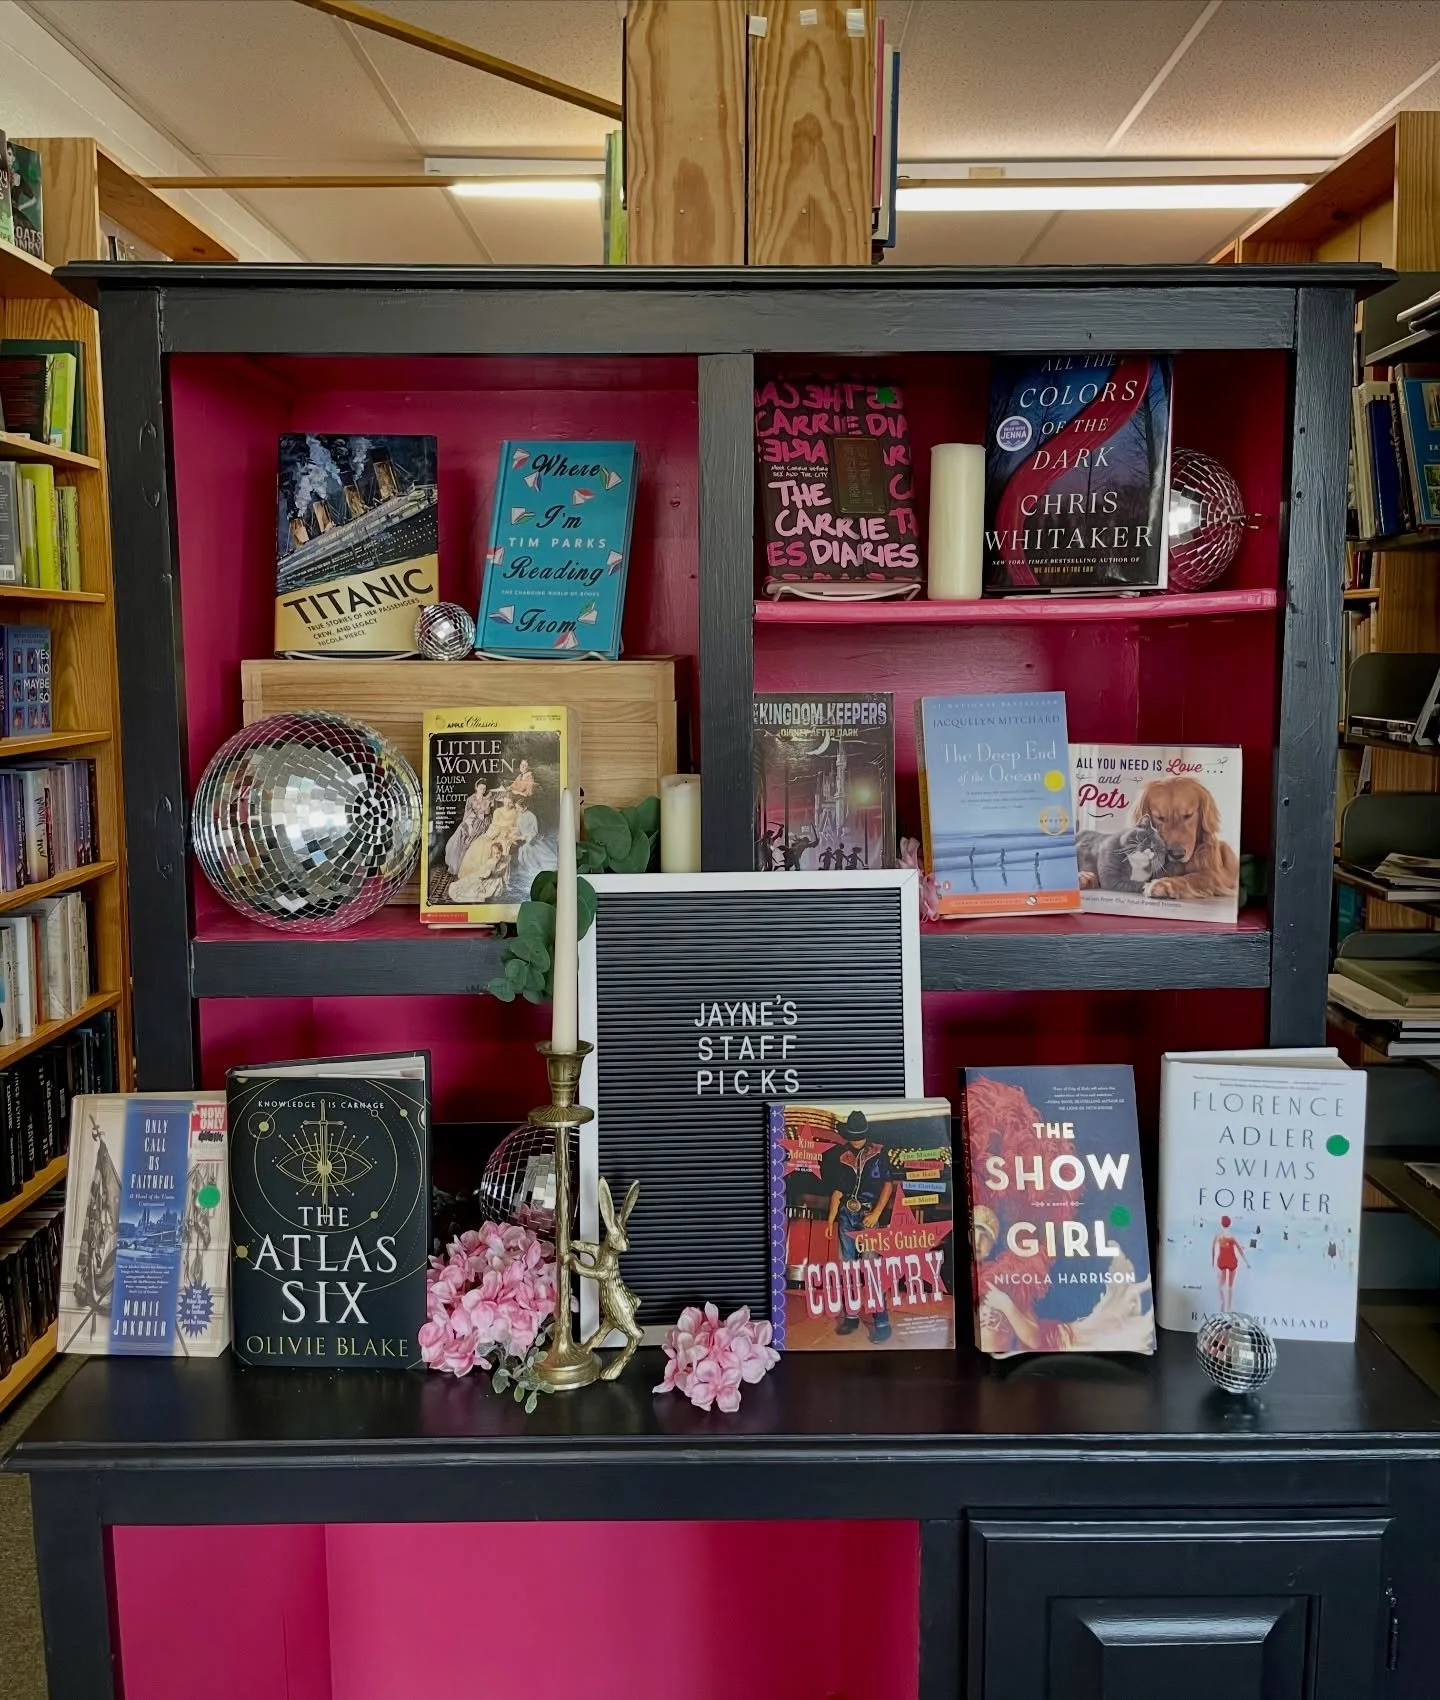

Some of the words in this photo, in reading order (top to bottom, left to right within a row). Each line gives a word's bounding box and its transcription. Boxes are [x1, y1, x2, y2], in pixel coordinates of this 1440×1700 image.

[1042, 358, 1073, 373] ALL
[1020, 380, 1138, 408] COLORS
[755, 408, 864, 437] CARRIE
[1041, 421, 1067, 435] OF
[1074, 417, 1109, 433] THE
[1001, 430, 1026, 439] JENNA
[532, 454, 601, 477] Where
[1032, 447, 1115, 471] DARK
[768, 480, 832, 508] THE
[1021, 491, 1118, 516] CHRIS
[536, 505, 582, 528] I'm
[775, 508, 889, 541] CARRIE
[508, 538, 539, 548] TIM
[552, 538, 606, 548] PARKS
[984, 526, 1153, 551] WHITAKER
[810, 538, 919, 569] DIARIES
[503, 556, 604, 587] Reading
[283, 568, 433, 624] TITANIC
[308, 622, 325, 632] TRUE
[326, 615, 352, 628] STORIES
[364, 609, 377, 617] HER
[379, 597, 423, 614] PASSENGERS,
[515, 609, 578, 633] From
[313, 630, 335, 640] CREW,
[336, 626, 351, 634] AND
[353, 618, 378, 630] LEGACY
[318, 635, 344, 647] NICOLA
[345, 630, 366, 640] PIERCE
[35, 648, 50, 660] YES
[38, 663, 50, 674] NO
[23, 679, 50, 690] MAYBE
[39, 692, 50, 703] SO
[464, 715, 499, 728] Classics
[759, 703, 823, 725] KINGDOM
[827, 702, 887, 725] KEEPERS
[933, 716, 995, 729] JACQUELYN
[999, 714, 1060, 725] MITCHARD
[811, 728, 835, 737] AFTER
[837, 728, 858, 737] DARK
[436, 739, 502, 756] LITTLE
[942, 742, 972, 764] The
[977, 742, 1021, 770] Deep
[1026, 739, 1056, 760] End
[436, 757, 516, 774] WOMEN
[957, 771, 968, 786] of
[970, 771, 985, 782] the
[989, 763, 1041, 783] Ocean
[1076, 758, 1093, 769] ALL
[1097, 758, 1116, 770] YOU
[1120, 759, 1149, 771] NEED
[1152, 759, 1163, 771] IS
[436, 775, 466, 785] LOUISA
[1097, 773, 1122, 784] and
[435, 785, 455, 794] MAY
[435, 793, 468, 803] ALCOTT
[1078, 783, 1129, 809] Pets
[694, 994, 798, 1027] JAYNE'S
[698, 1035, 797, 1061] STAFF
[697, 1068, 800, 1095] PICKS
[200, 1107, 225, 1119] NOW
[340, 1101, 385, 1109] CARNAGE
[1193, 1091, 1345, 1117] FLORENCE
[145, 1118, 169, 1134] ONLY
[200, 1118, 224, 1130] ONLY
[1032, 1122, 1075, 1139] THE
[144, 1137, 166, 1153] CALL
[798, 1138, 815, 1149] Kim
[1219, 1125, 1315, 1150] ADLER
[148, 1156, 160, 1171] US
[788, 1149, 823, 1161] Adelman
[985, 1153, 1130, 1191] SHOW
[1216, 1156, 1317, 1181] SWIMS
[130, 1174, 175, 1190] FAITHFUL
[1199, 1187, 1331, 1214] FOREVER
[298, 1206, 349, 1227] THE
[894, 1230, 936, 1249] Guide
[1006, 1220, 1120, 1258] GIRL
[252, 1233, 398, 1273] ATLAS
[806, 1250, 945, 1316] COUNTRY
[994, 1273, 1052, 1284] NICOLA
[1058, 1271, 1136, 1284] HARRISON
[281, 1280, 369, 1324] SIX
[246, 1335, 326, 1356] OLIVIE
[337, 1337, 409, 1357] BLAKE
